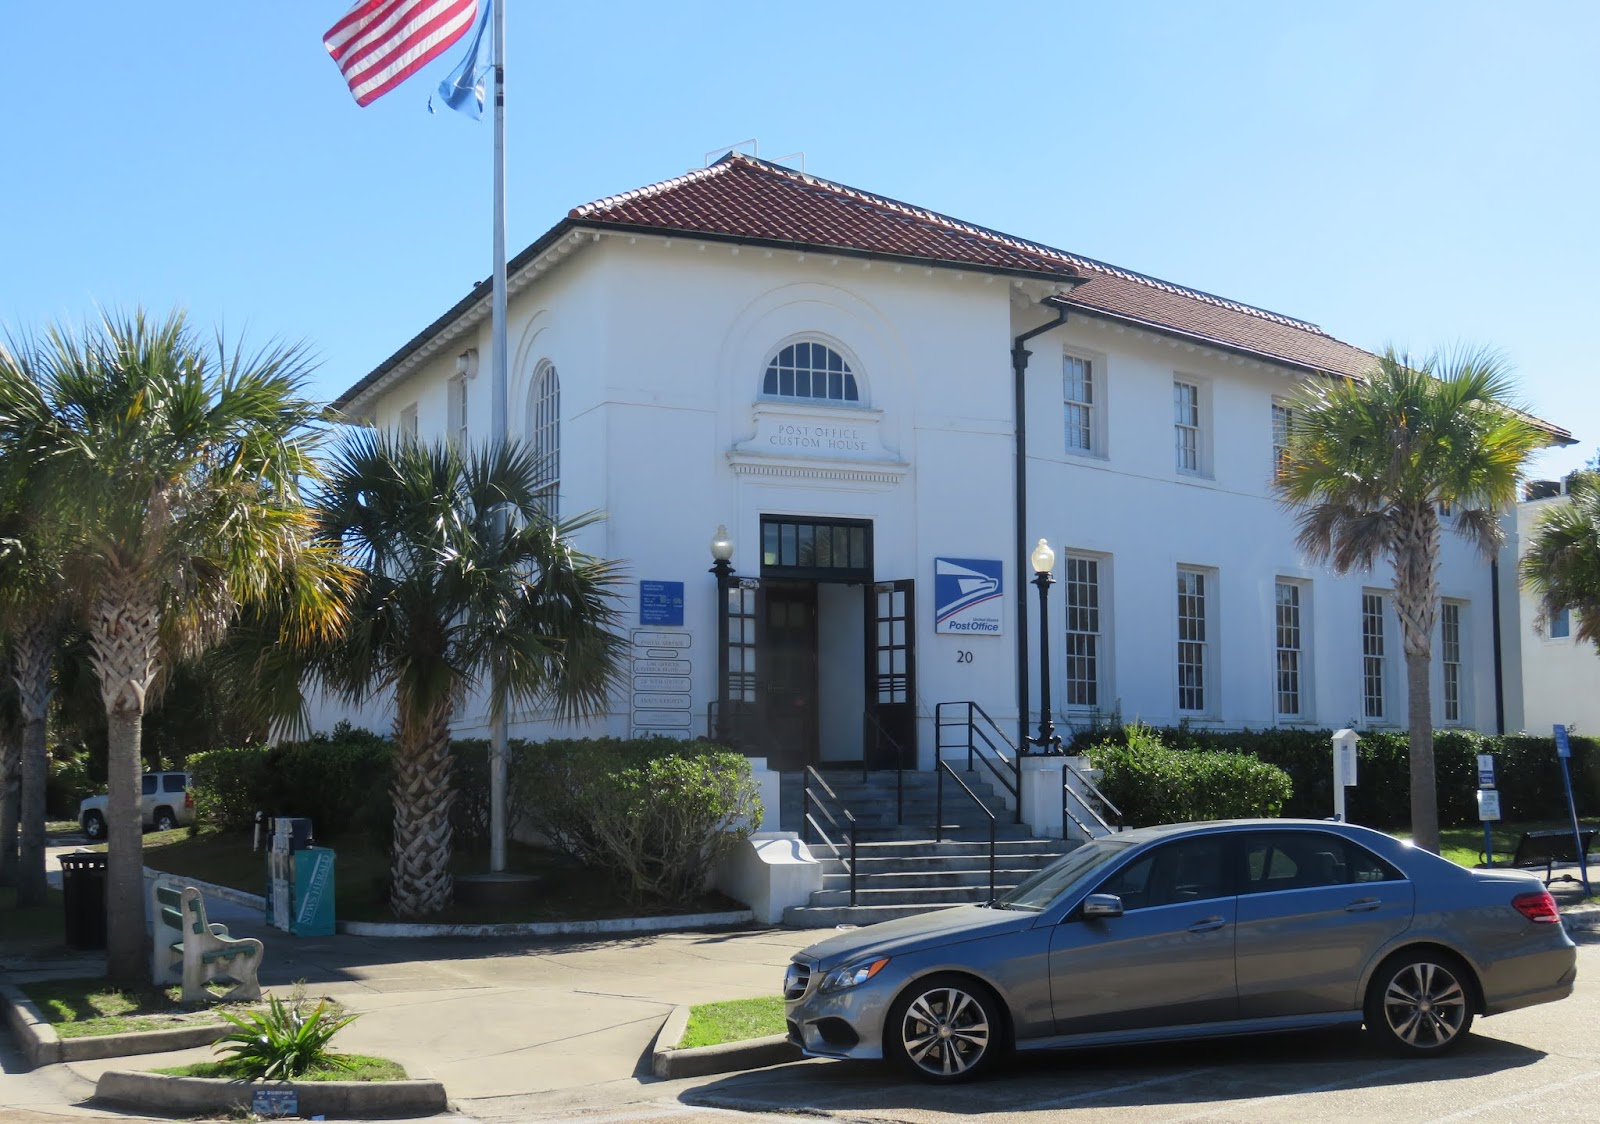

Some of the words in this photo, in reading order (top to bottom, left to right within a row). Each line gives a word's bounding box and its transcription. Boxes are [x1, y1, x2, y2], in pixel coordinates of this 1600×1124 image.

[778, 424, 809, 436] POST
[815, 427, 859, 439] OFFICE
[769, 435, 820, 448] CUSTOM
[828, 440, 868, 450] HOUSE
[956, 650, 973, 663] 20
[302, 896, 316, 925] NEWS
[311, 854, 330, 896] HERALD
